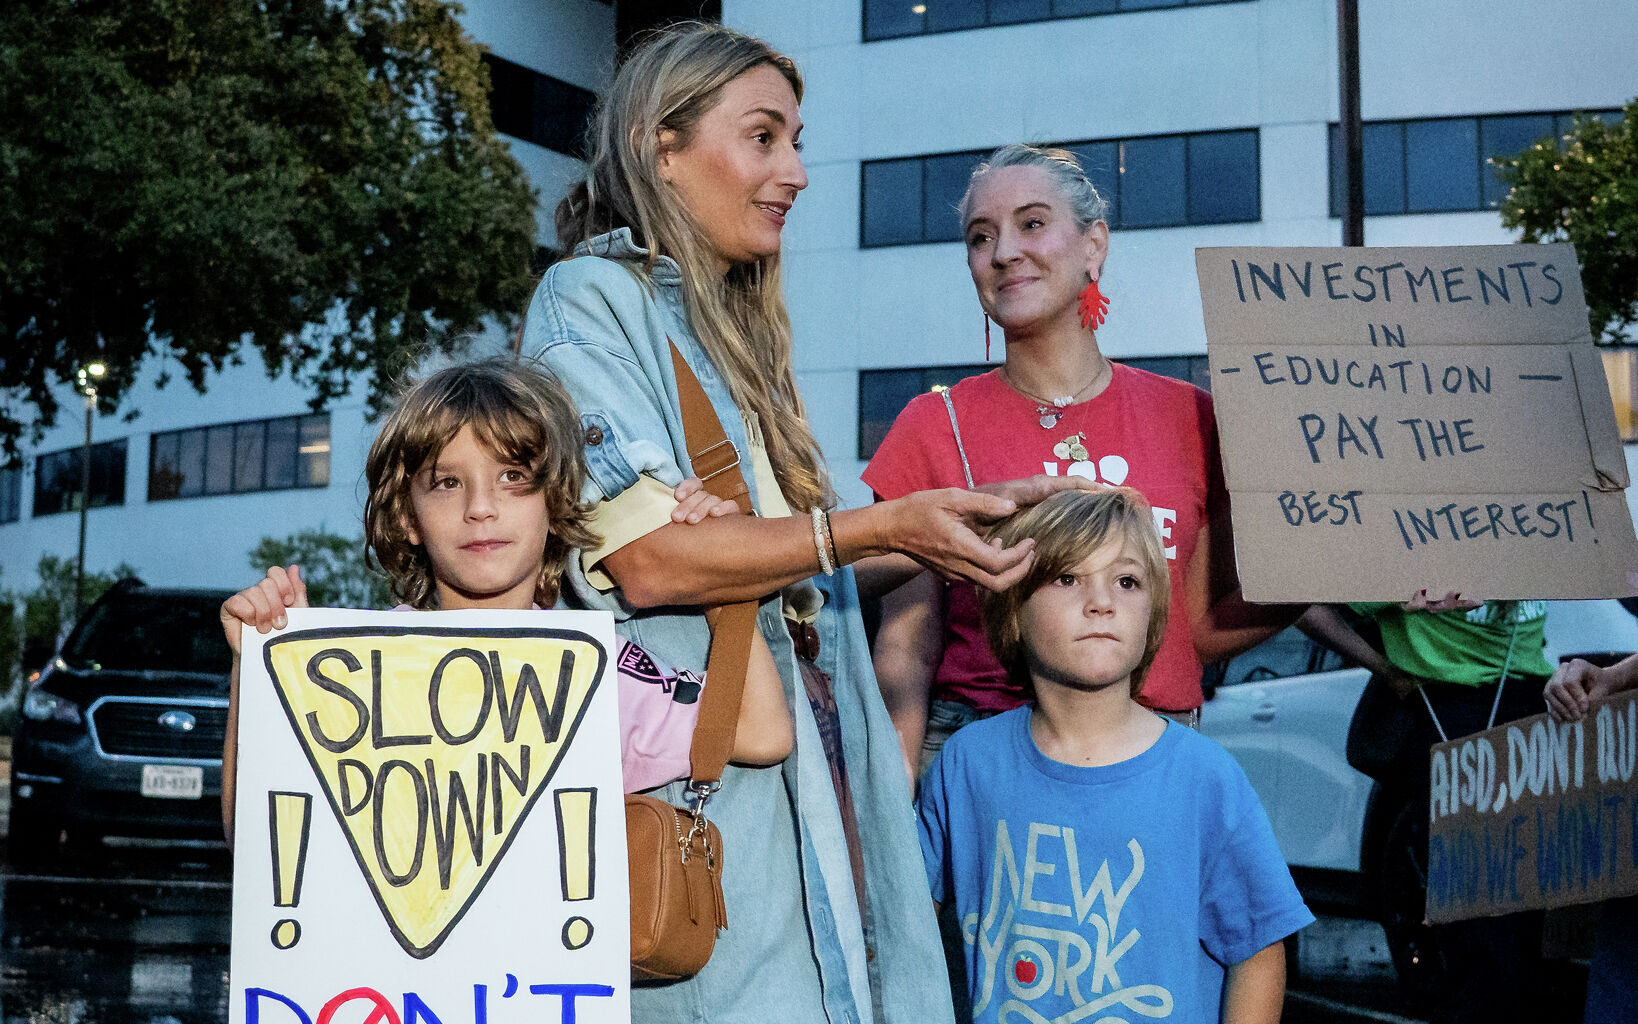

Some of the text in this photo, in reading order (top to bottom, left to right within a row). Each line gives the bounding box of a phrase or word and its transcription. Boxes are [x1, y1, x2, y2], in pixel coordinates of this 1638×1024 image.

[1231, 258, 1564, 308] INVESTMENTS
[1367, 323, 1407, 348] IN
[1252, 352, 1492, 395] EDUCATION
[1297, 412, 1485, 464] PAY THE
[1277, 490, 1600, 551] BEST INTEREST!
[622, 647, 645, 669] MLS
[305, 647, 576, 754] SLOW
[1431, 737, 1508, 823] AISD,
[337, 744, 531, 890] DOWN
[982, 819, 1145, 945] NEW
[1484, 814, 1529, 907] WE
[962, 901, 1142, 1019] YORK
